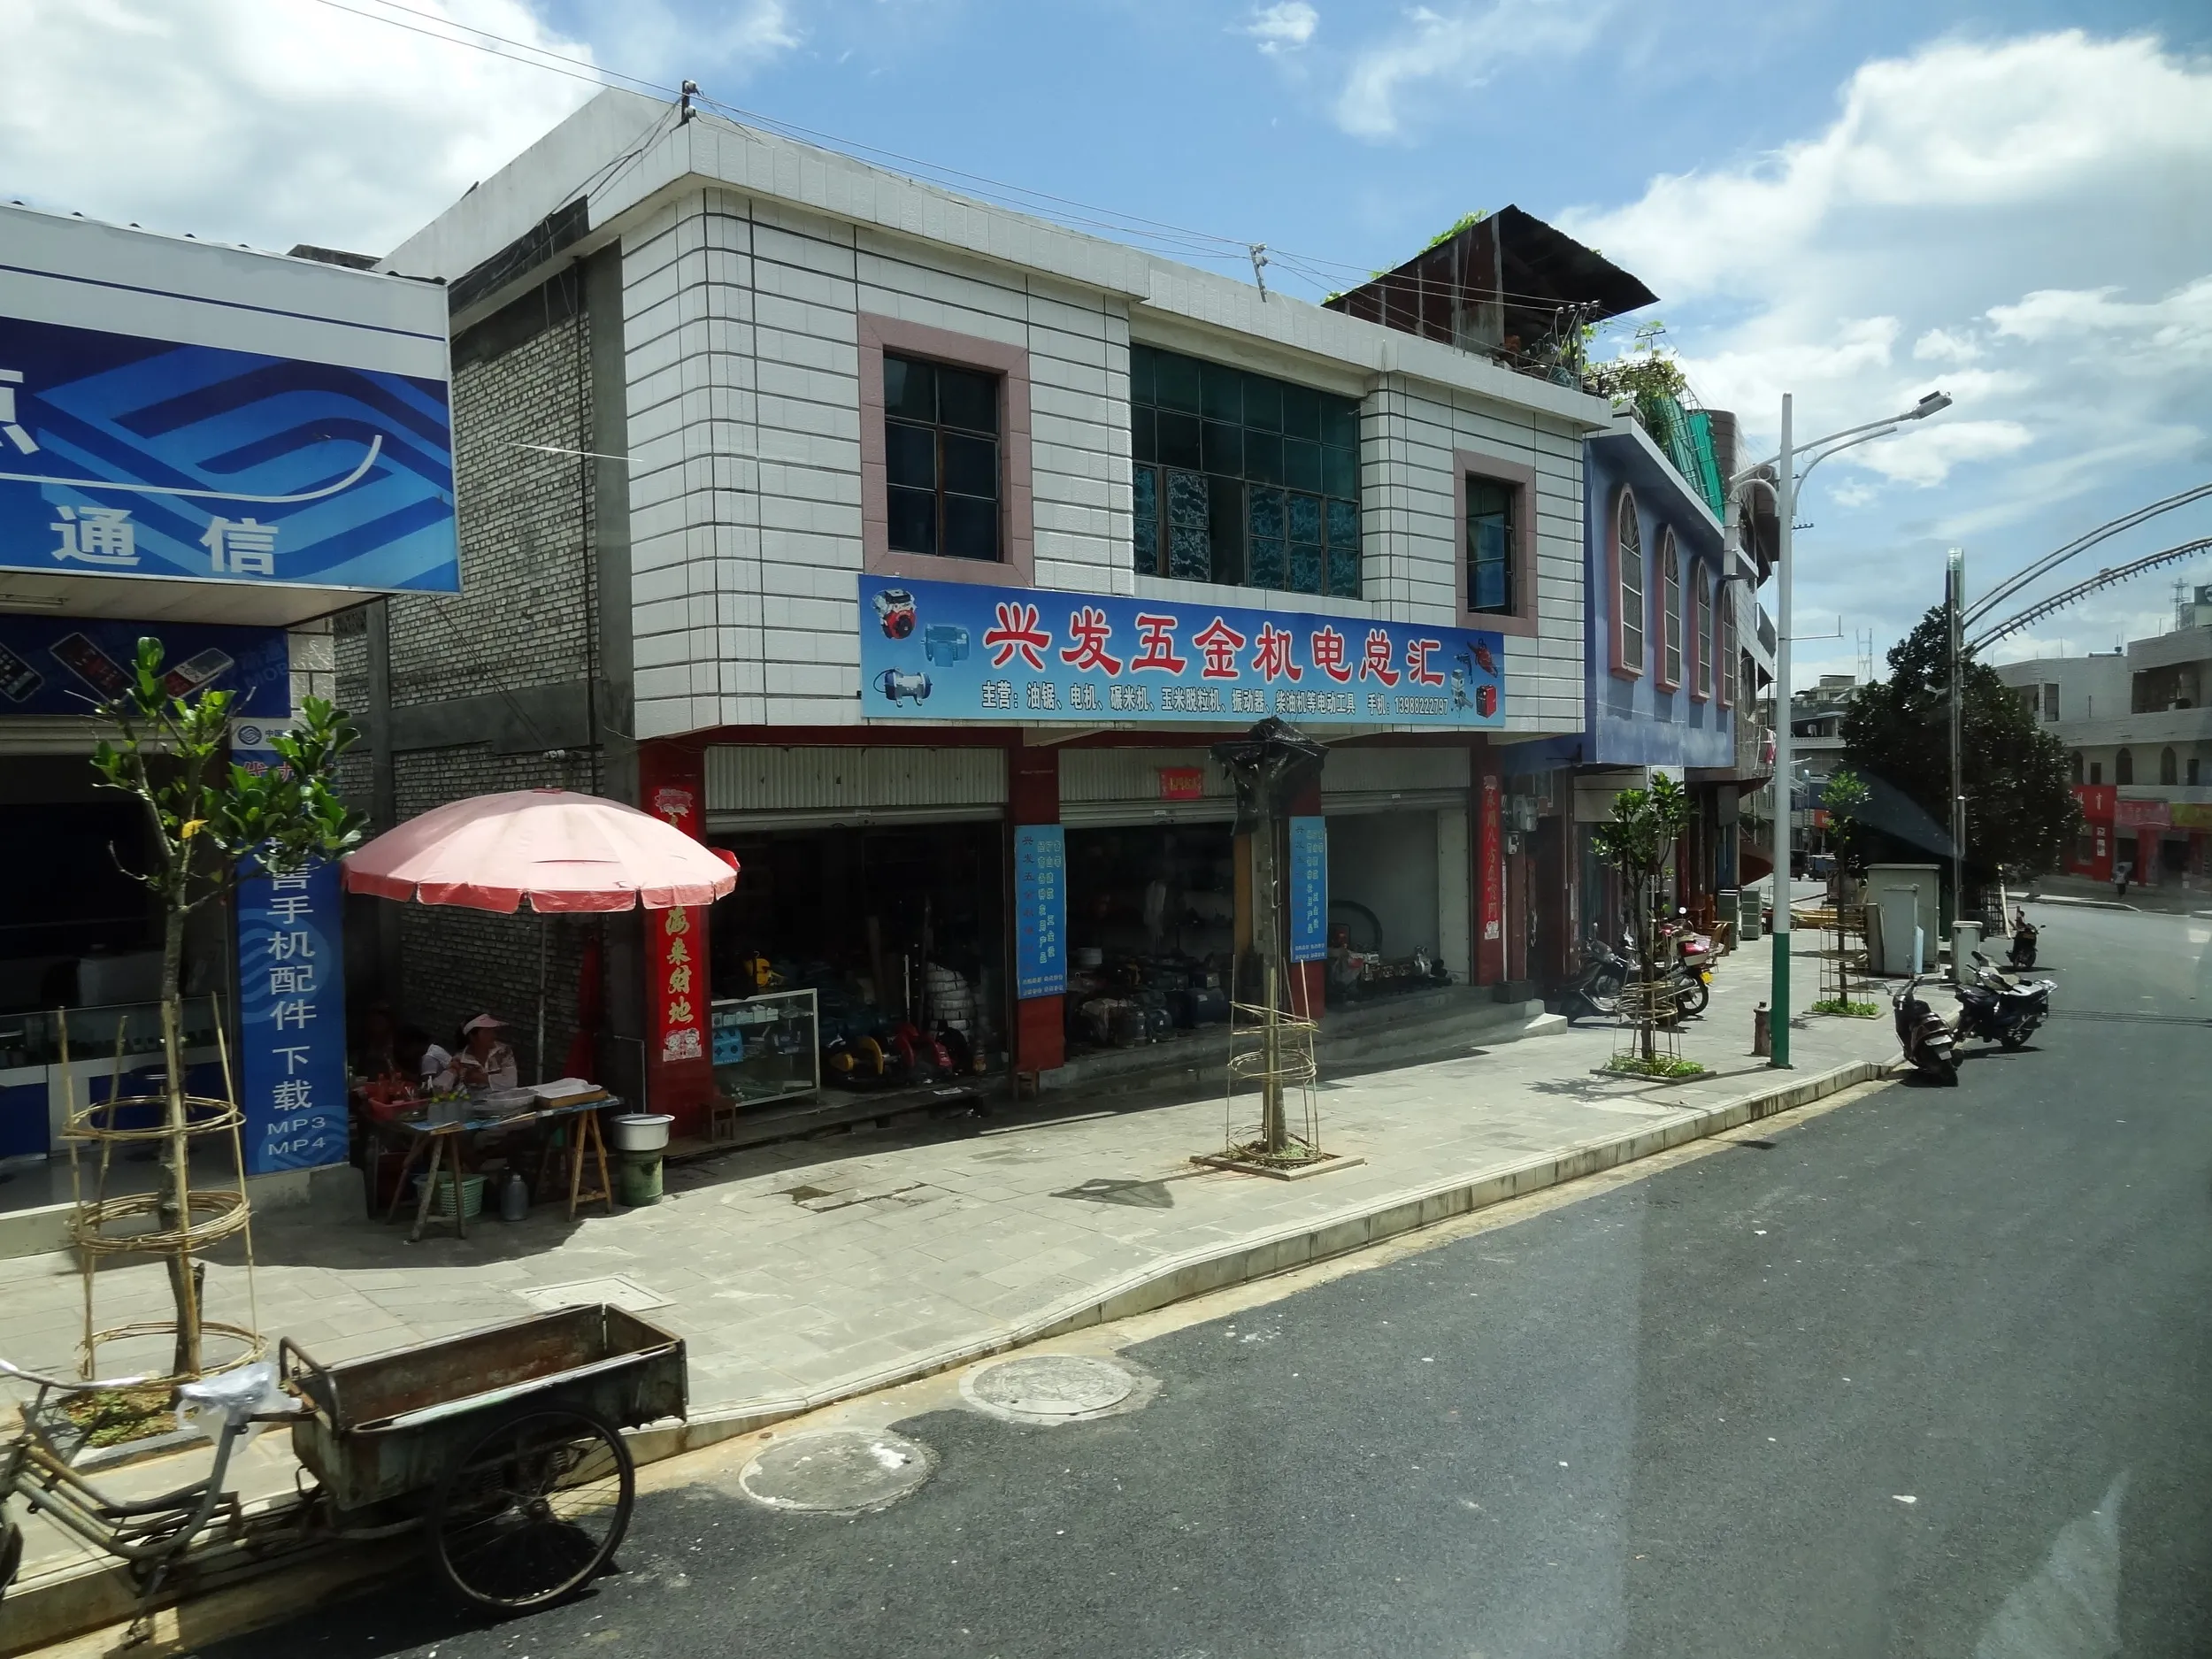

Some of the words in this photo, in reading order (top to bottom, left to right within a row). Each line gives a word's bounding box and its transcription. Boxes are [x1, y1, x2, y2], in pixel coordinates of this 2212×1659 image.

[50, 505, 280, 576] 通信
[984, 601, 1447, 687] 兴发五金机电总汇
[272, 1045, 312, 1111] 下载
[267, 1116, 326, 1136] MP3
[268, 1136, 326, 1156] MP4
